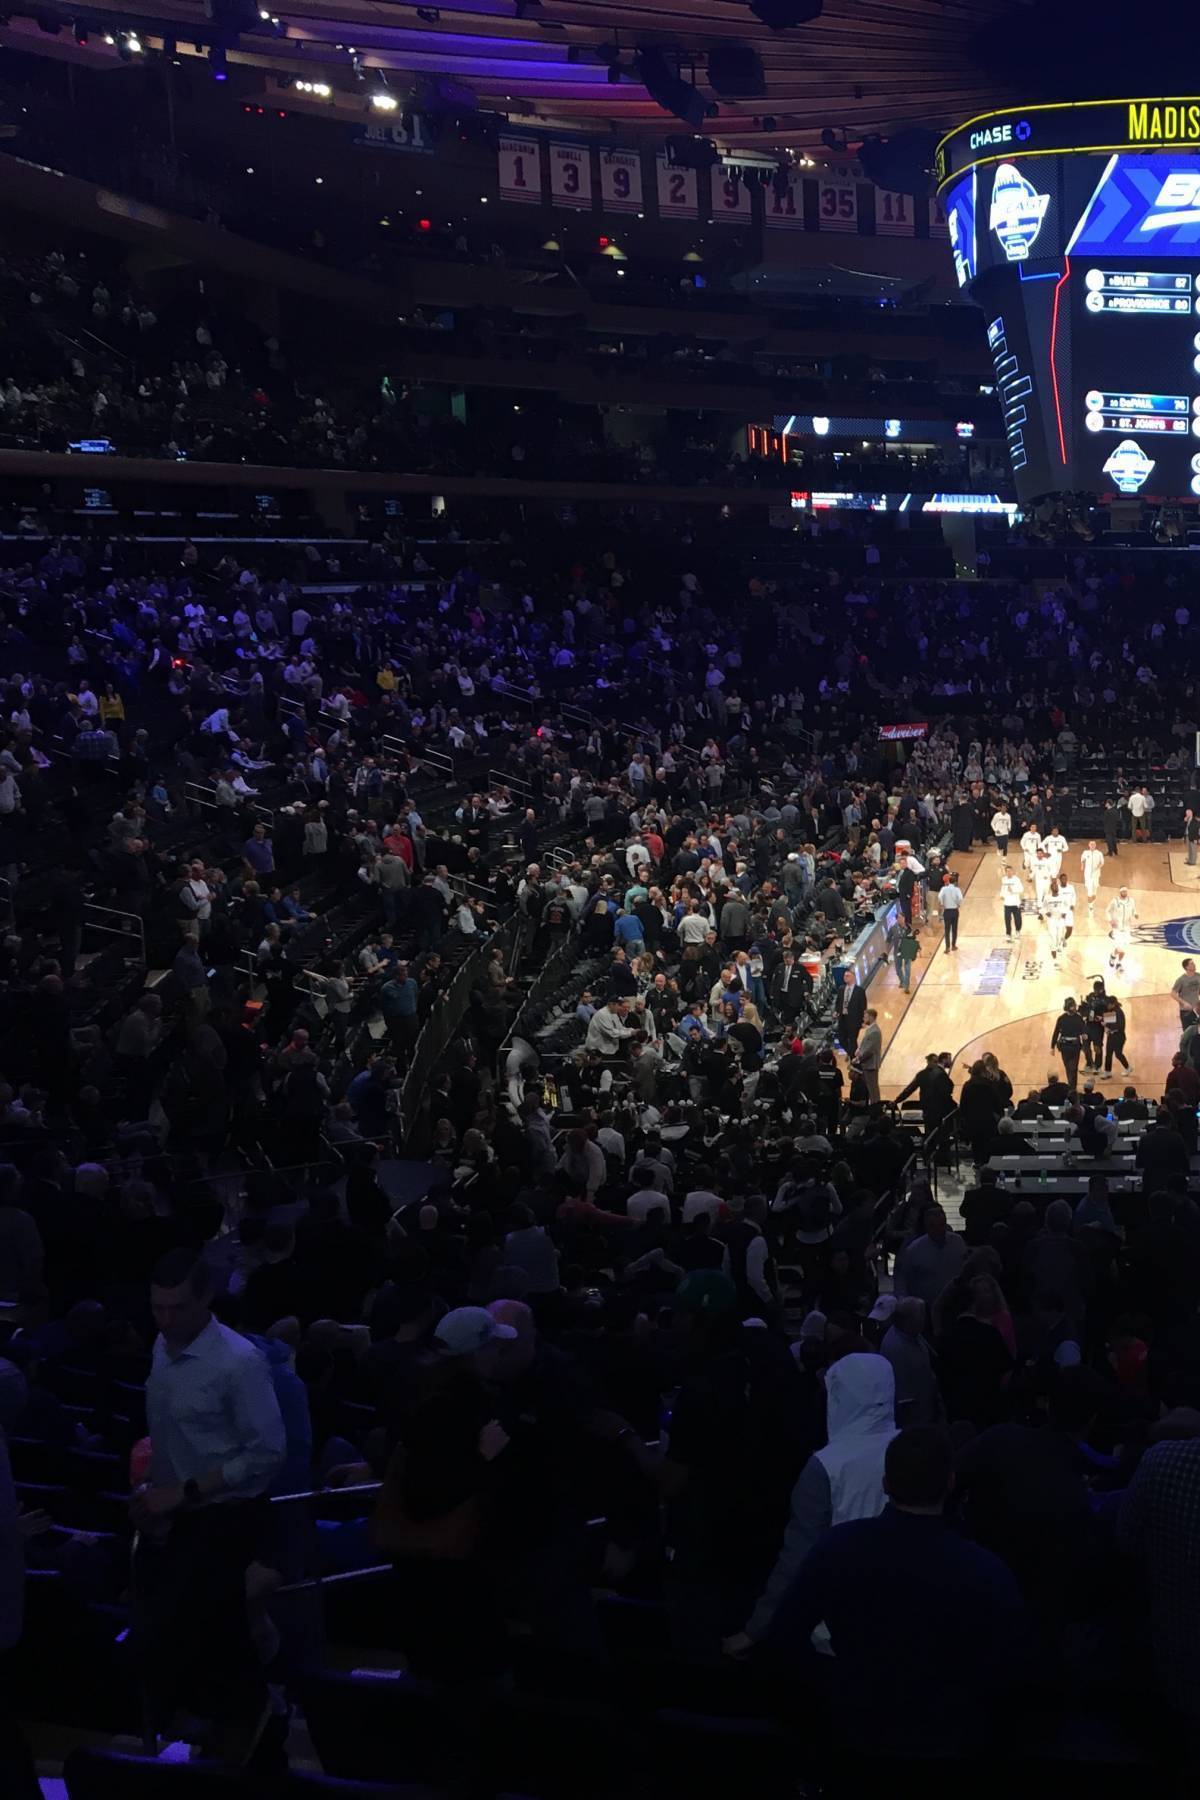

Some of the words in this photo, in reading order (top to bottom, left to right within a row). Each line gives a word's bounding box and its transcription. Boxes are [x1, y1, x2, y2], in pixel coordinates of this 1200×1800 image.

[970, 125, 1013, 149] CHASE
[514, 156, 527, 188] 1
[562, 163, 580, 193] 3
[614, 167, 631, 198] 9
[669, 174, 687, 204] 2
[821, 188, 855, 219] 35
[883, 193, 907, 222] 11
[1114, 276, 1149, 288] BUTLER
[1113, 298, 1171, 310] PROVIDENCE
[1174, 399, 1186, 410] 74
